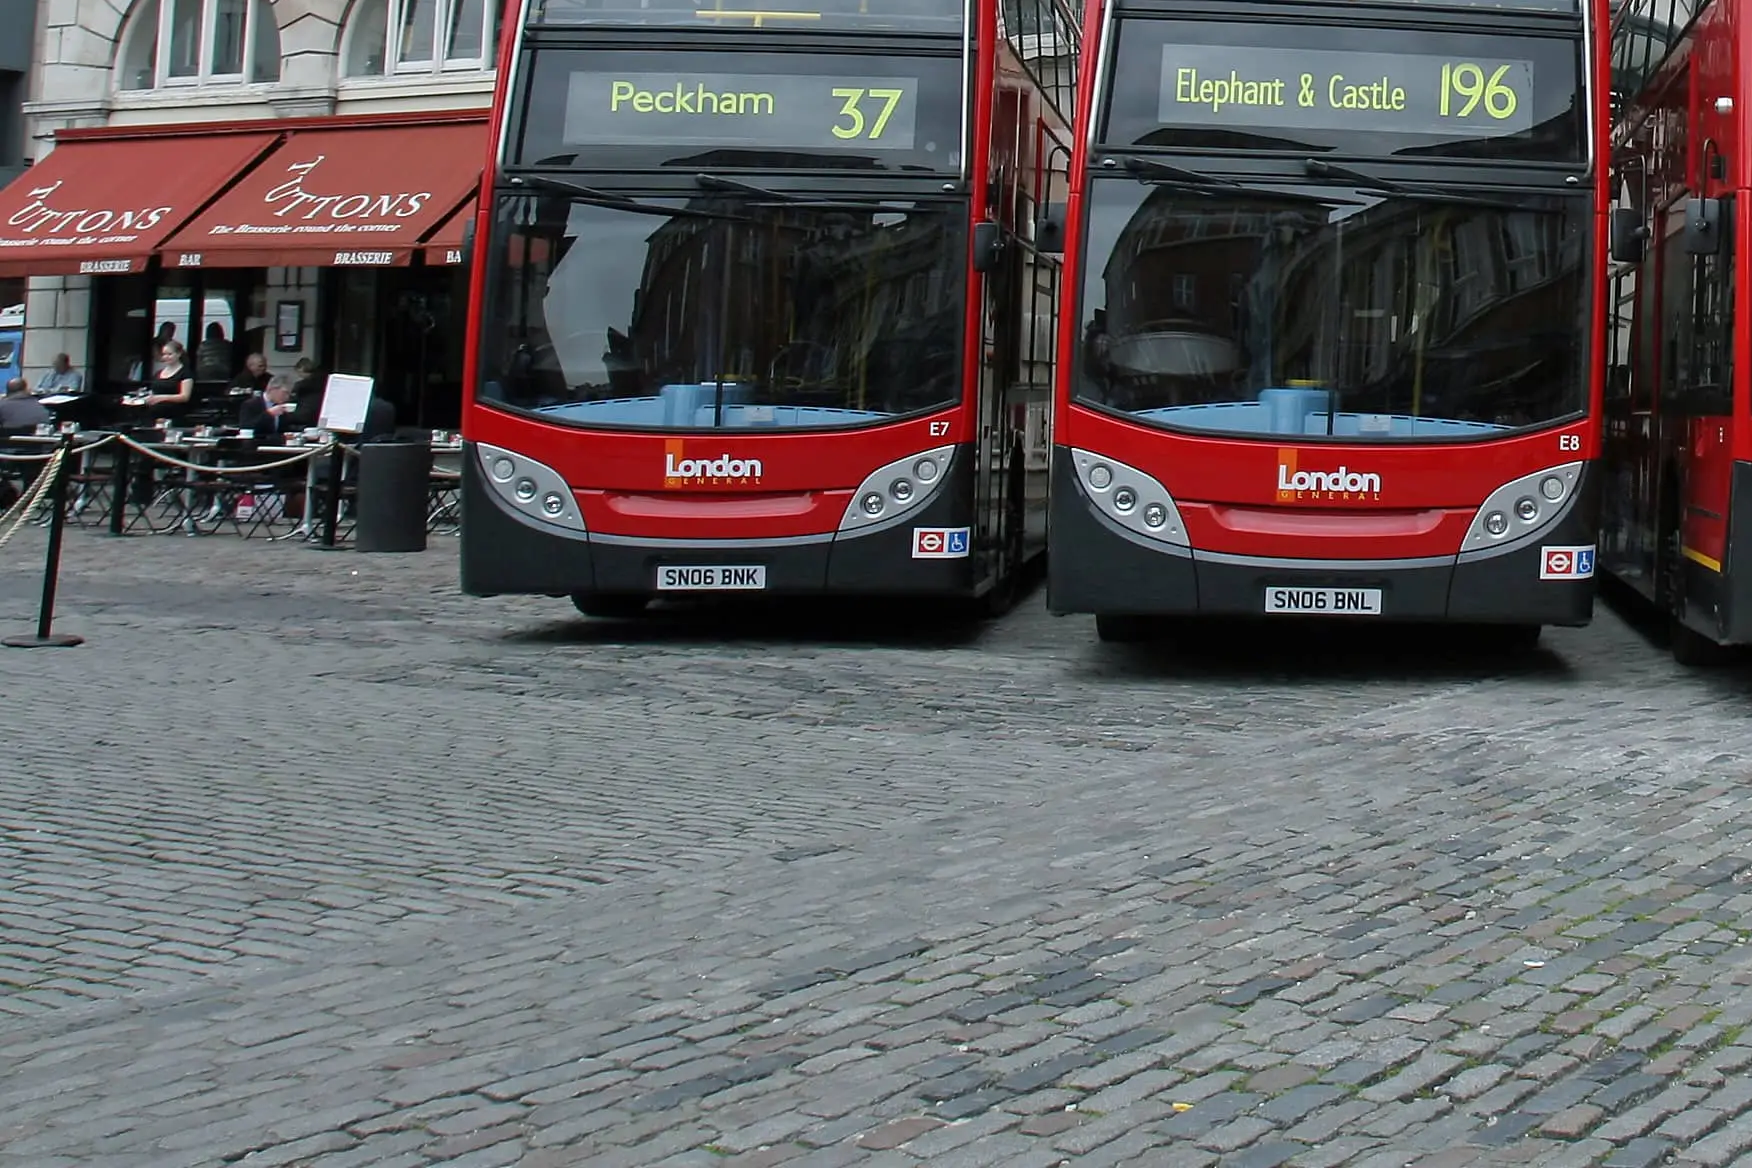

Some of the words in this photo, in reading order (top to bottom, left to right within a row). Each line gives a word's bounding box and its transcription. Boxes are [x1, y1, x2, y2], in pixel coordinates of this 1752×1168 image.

[1176, 67, 1284, 113] Elephant
[1299, 74, 1316, 108] &
[1329, 74, 1406, 111] Castle
[1440, 63, 1518, 120] 196
[610, 81, 775, 115] Peckham
[831, 88, 904, 140] 37
[262, 155, 431, 220] TUTTONS
[8, 181, 172, 233] TUTTONS
[79, 259, 131, 273] BRASSERIE
[179, 253, 201, 266] BAR
[334, 252, 393, 265] BRASSERIE
[929, 420, 950, 437] E7
[1559, 433, 1580, 451] E8
[665, 453, 762, 478] London
[668, 477, 761, 485] GENERAL
[1279, 464, 1380, 492] London
[1281, 490, 1380, 501] GENERAL
[664, 569, 714, 586] SN06
[720, 569, 758, 586] BNK
[1273, 590, 1327, 610] SN06
[1333, 590, 1373, 611] BNL
